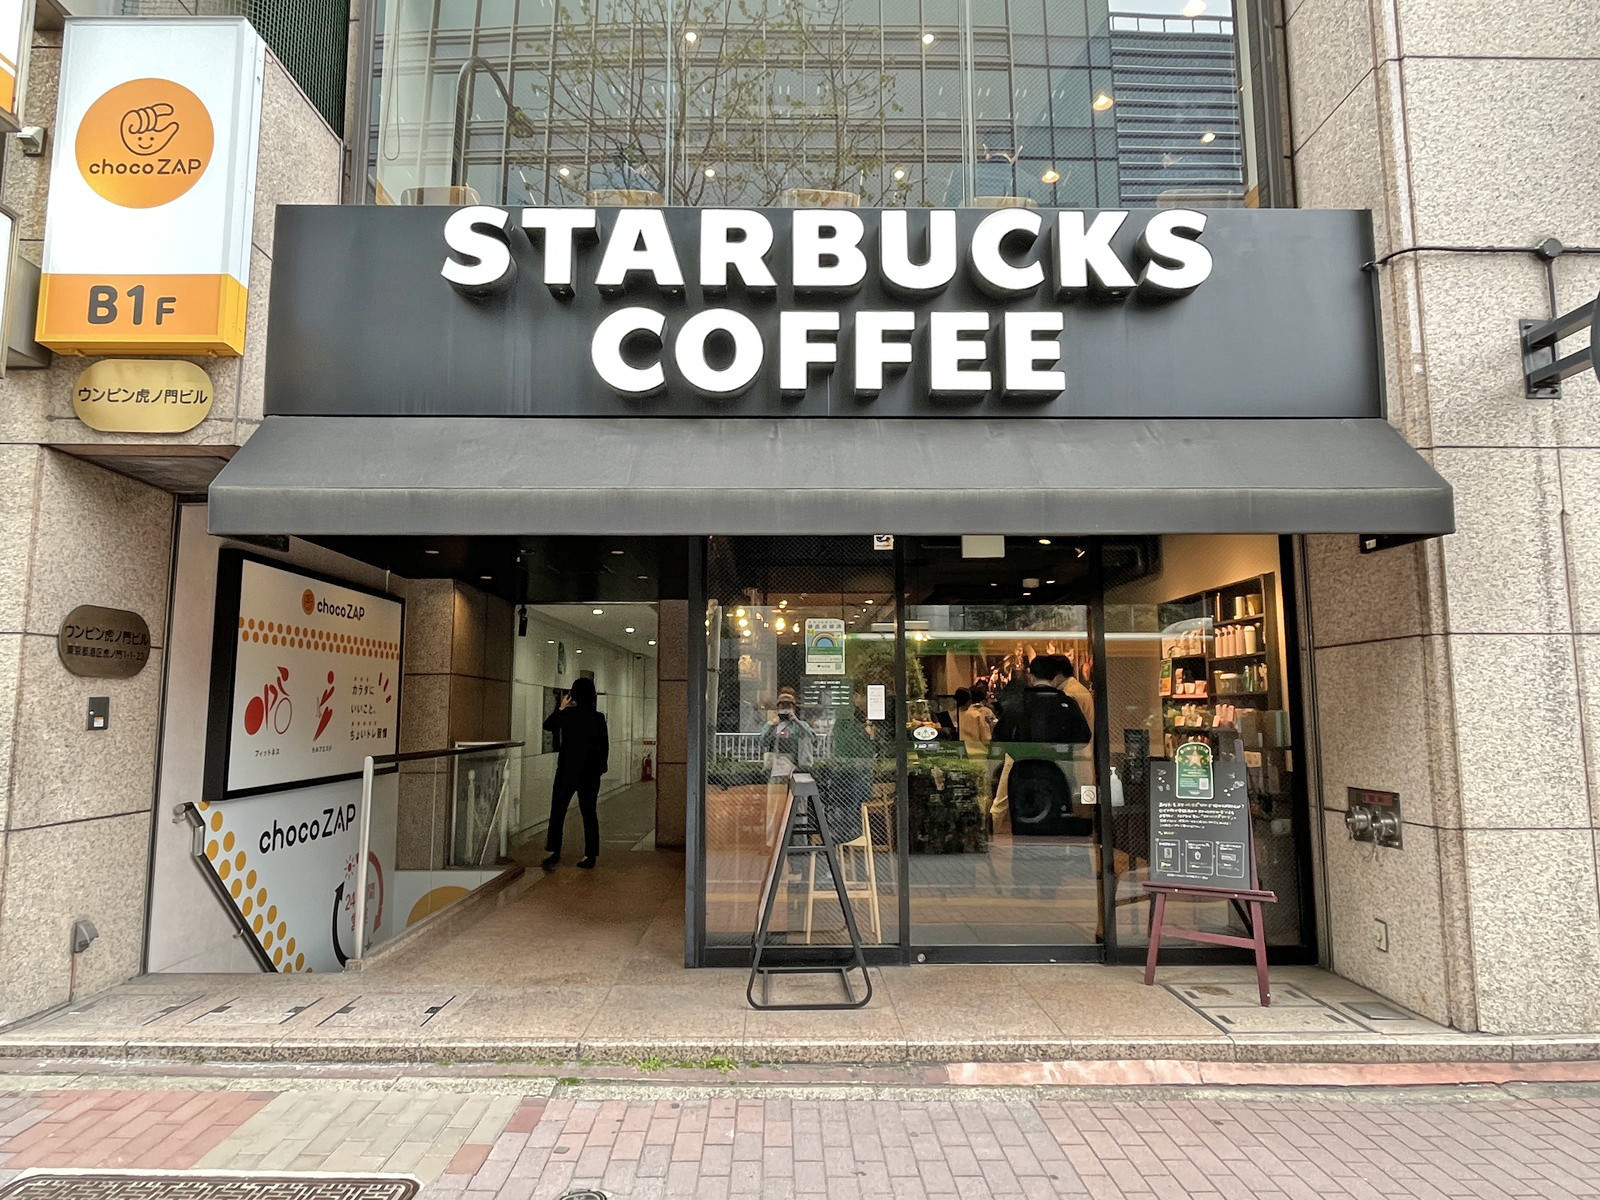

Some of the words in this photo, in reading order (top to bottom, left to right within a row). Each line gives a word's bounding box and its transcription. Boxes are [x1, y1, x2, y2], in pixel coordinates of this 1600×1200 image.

[88, 158, 202, 176] chocoZAP
[441, 207, 1213, 290] STARBUCKS
[591, 305, 1066, 394] COFFEE
[317, 597, 365, 620] chocoZAP
[259, 804, 356, 853] chocoZAP
